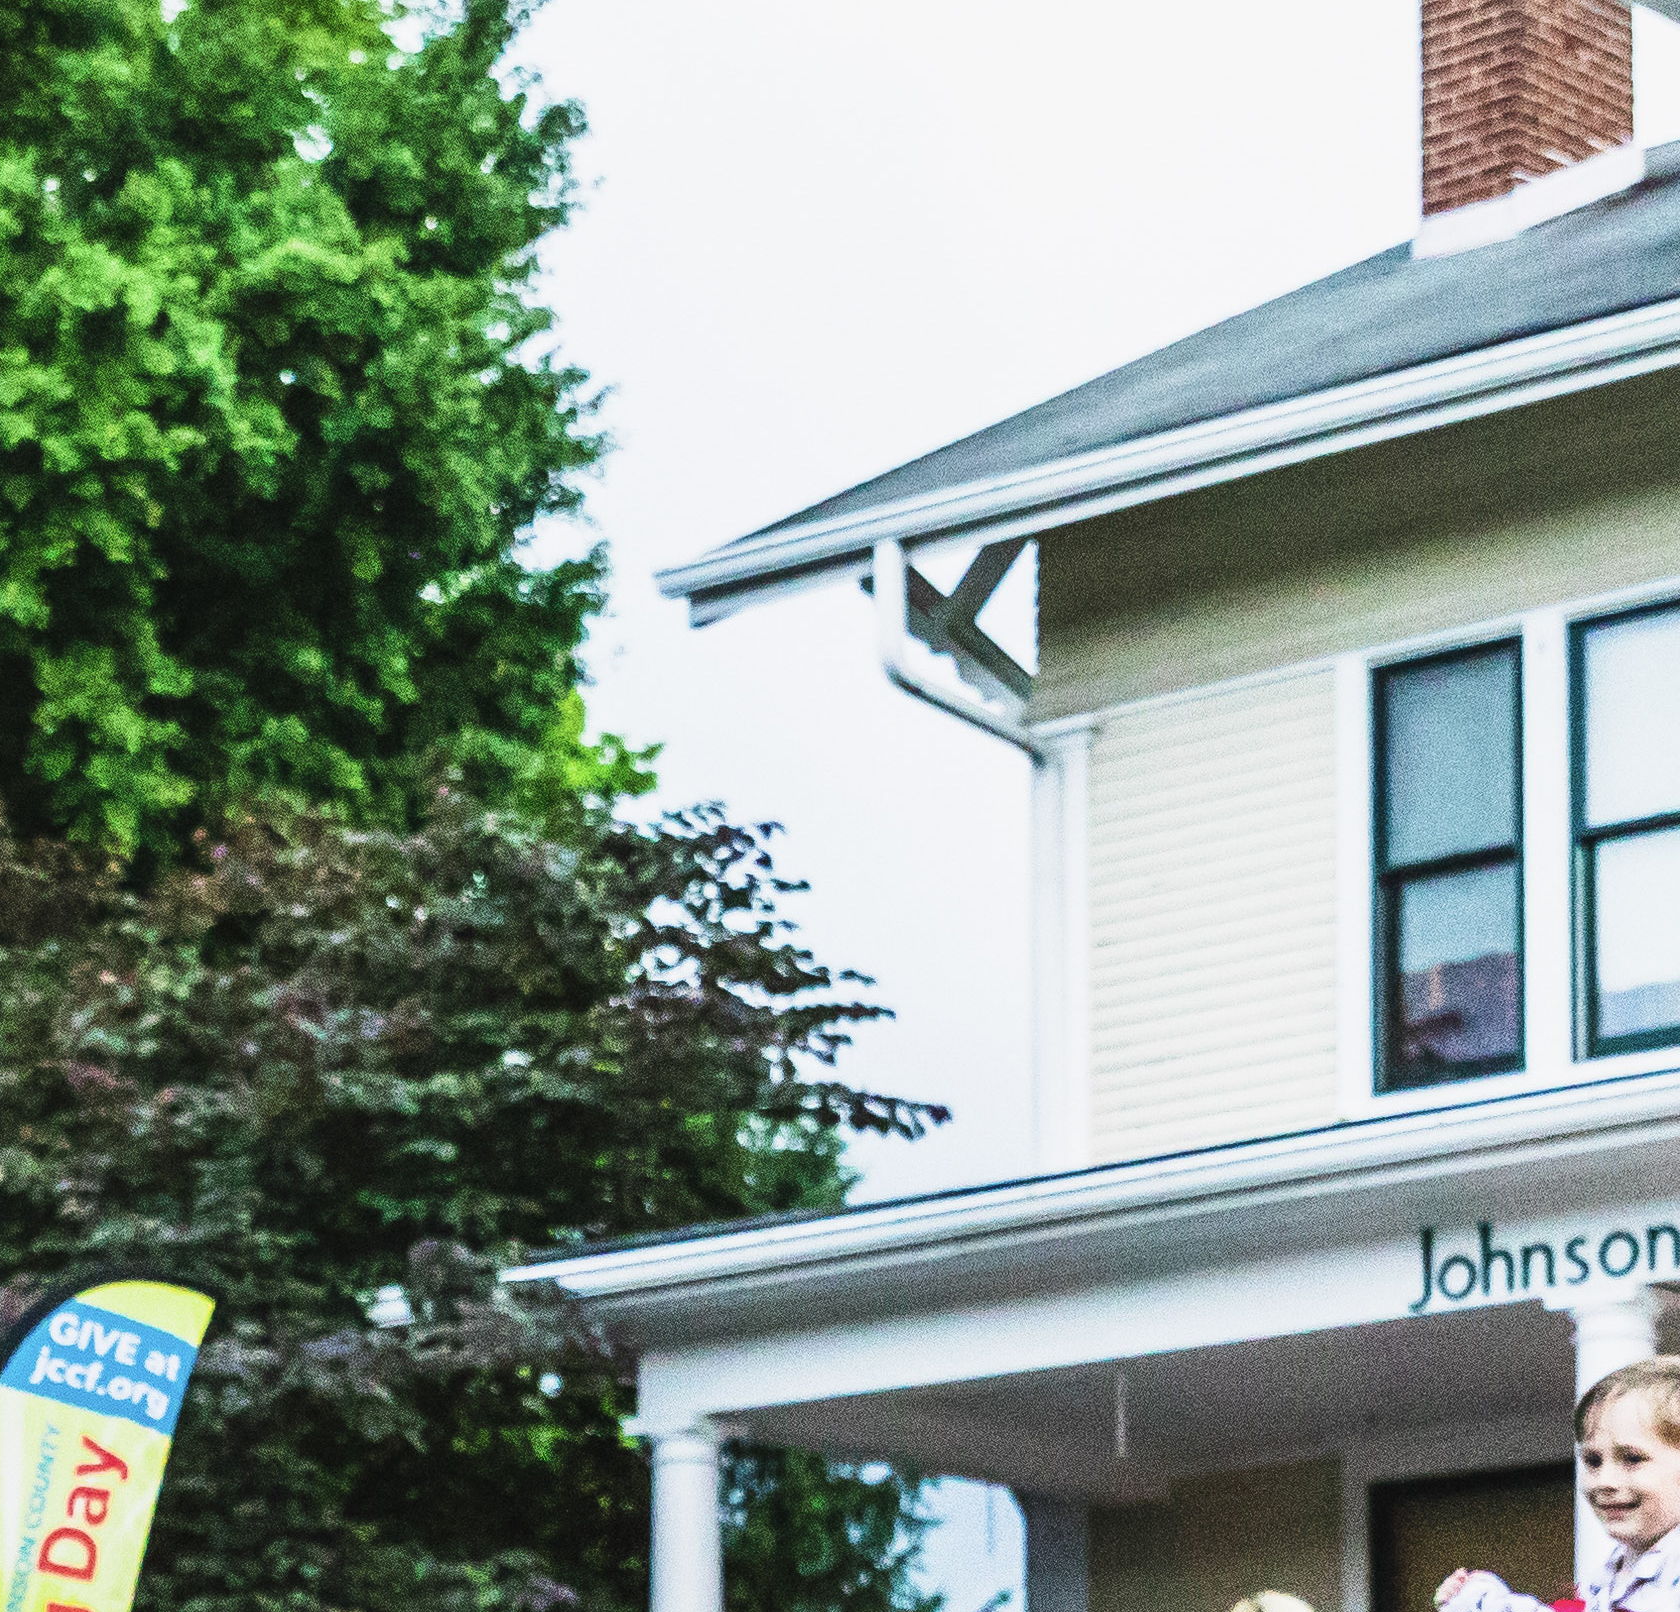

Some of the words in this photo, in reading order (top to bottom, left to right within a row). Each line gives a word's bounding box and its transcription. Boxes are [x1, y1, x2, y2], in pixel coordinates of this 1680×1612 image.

[28, 1345, 171, 1421] jccf.org
[49, 1311, 142, 1367] GIVE
[144, 1350, 181, 1382] at
[37, 1434, 129, 1582] Day
